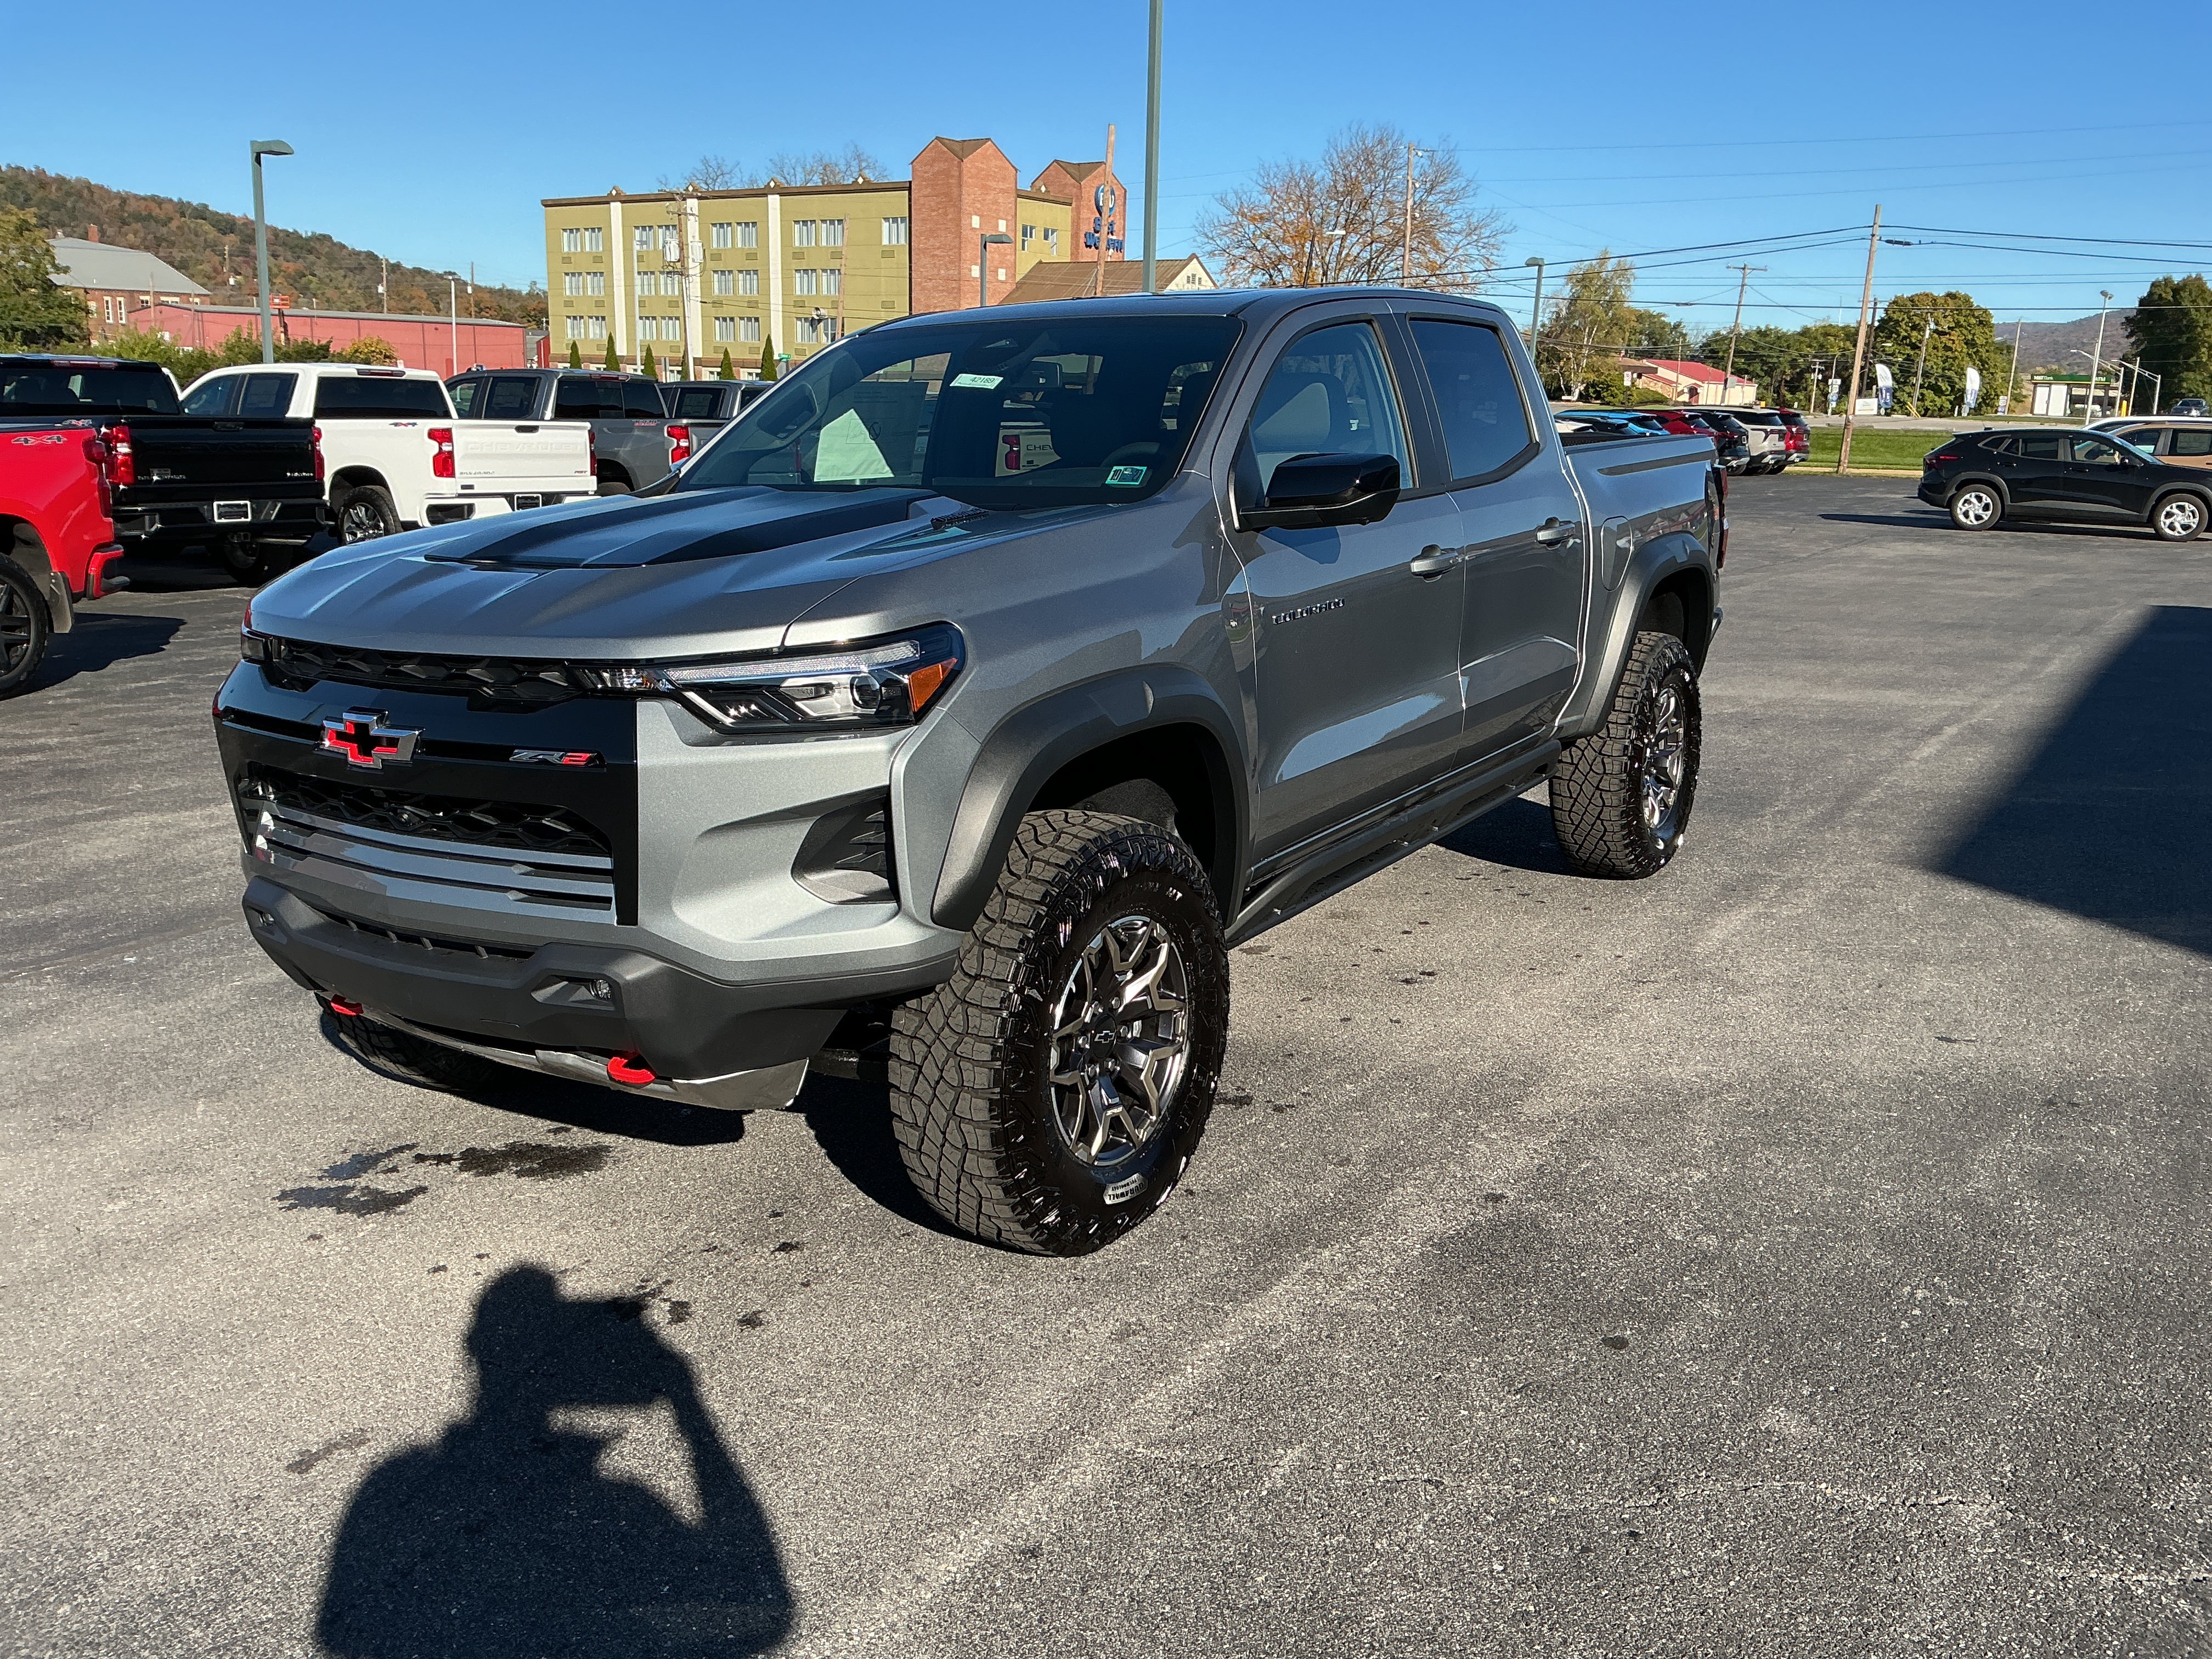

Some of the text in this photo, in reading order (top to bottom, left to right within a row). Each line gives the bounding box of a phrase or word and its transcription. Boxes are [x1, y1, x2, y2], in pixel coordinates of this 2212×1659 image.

[467, 442, 584, 453] CHEVROLET
[1272, 597, 1345, 625] COLORADO
[509, 749, 595, 768] ZR2
[1108, 1182, 1144, 1201] DURAWALL
